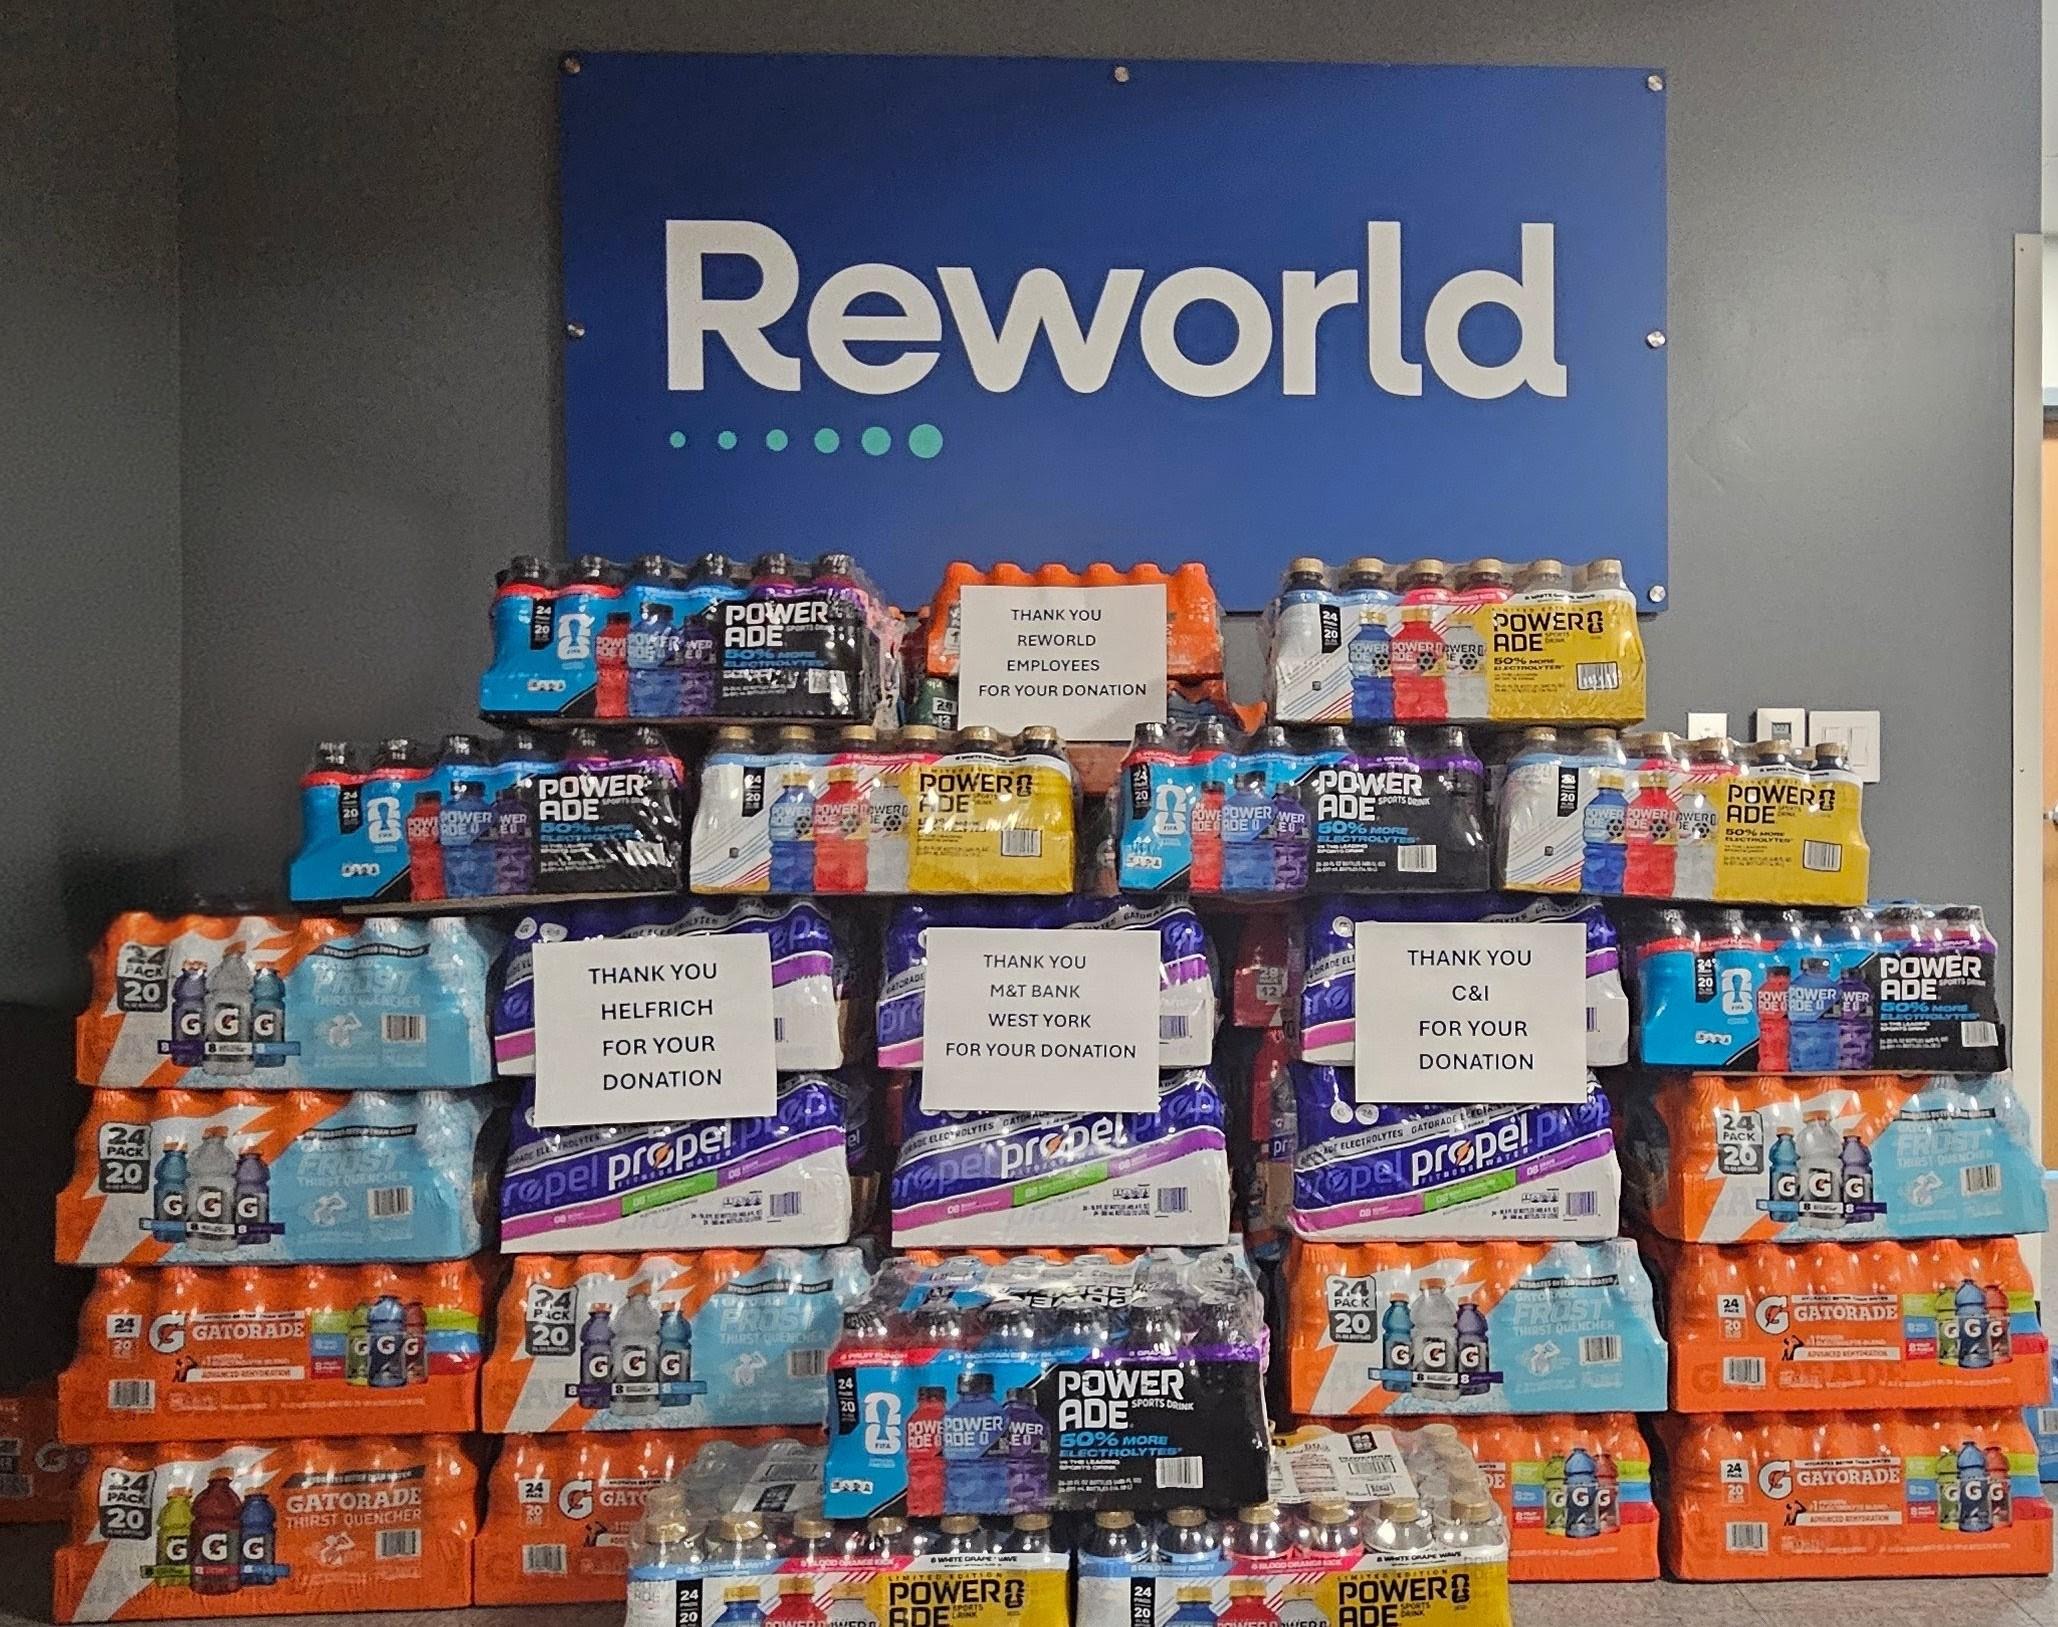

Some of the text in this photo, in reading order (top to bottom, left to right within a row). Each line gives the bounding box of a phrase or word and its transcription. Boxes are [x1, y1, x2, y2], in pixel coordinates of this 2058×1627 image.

[666, 220, 1568, 401] Reworld
[726, 602, 828, 626] POWER
[1011, 609, 1101, 621] THANK YOU
[1493, 613, 1584, 632] POWER
[725, 625, 783, 648] ADE
[1018, 634, 1096, 646] REWORLD
[1494, 634, 1543, 652] ADE
[1007, 660, 1100, 672] EMPLOYEES
[979, 684, 1147, 697] FOR YOUR DONATION
[540, 775, 644, 799] POWER
[920, 774, 1012, 792] POWER
[1319, 770, 1422, 795] POWER
[1378, 797, 1430, 806] SPORTS DRINK
[1728, 784, 1815, 805] POWER
[540, 799, 599, 820] ADE
[1224, 806, 1272, 819] POWER
[1318, 794, 1376, 821] ADE
[1628, 809, 1668, 819] POWER
[1727, 805, 1776, 824] ADE
[1318, 821, 1367, 834] 50%
[984, 955, 1086, 969] THANK YOU
[1408, 950, 1532, 966] THANK YOU
[1880, 956, 1981, 978] POWER
[124, 964, 164, 977] PACK
[588, 963, 717, 985] THANK YOU
[124, 981, 161, 1002] 20
[990, 984, 1080, 998] M&T BANK
[1881, 979, 1936, 1000] ADE
[1939, 978, 1965, 986] SPORTS
[1452, 985, 1488, 1001] C&I
[1789, 987, 1836, 1000] POWER
[601, 999, 713, 1020] HELFRICH
[215, 1008, 239, 1036] G
[989, 1014, 1091, 1028] WEST YORK
[1419, 1021, 1528, 1037] FOR YOUR
[603, 1036, 715, 1056] FOR YOUR
[946, 1043, 1136, 1058] FOR YOUR DONATION
[1420, 1054, 1533, 1070] DONATION
[603, 1069, 722, 1090] DONATION
[1411, 1115, 1457, 1135] GATORADE
[1723, 1114, 1755, 1131] 24
[108, 1127, 146, 1145] 24
[1001, 1112, 1126, 1179] propel
[1340, 1128, 1403, 1150] ELECTROLYTES
[1723, 1132, 1755, 1141] PACK
[107, 1146, 144, 1157] PACK
[608, 1119, 732, 1192] propel
[1411, 1113, 1529, 1187] propel
[1724, 1146, 1757, 1166] 20
[106, 1162, 142, 1185] 20
[1809, 1173, 1832, 1197] G
[1846, 1177, 1864, 1197] G
[198, 1192, 222, 1218] G
[1334, 1299, 1369, 1307] PACK
[1515, 1300, 1603, 1325] FROST
[1723, 1299, 1739, 1308] 24
[1794, 1305, 1897, 1321] GATORADE
[114, 1318, 134, 1329] 24
[1335, 1313, 1370, 1333] 20
[1755, 1296, 1788, 1335] G
[150, 1314, 186, 1353] G
[192, 1323, 305, 1341] GATORADE
[532, 1325, 569, 1346] 20
[1964, 1318, 1982, 1339] G
[377, 1336, 396, 1354] G
[1391, 1345, 1409, 1365] G
[1424, 1342, 1446, 1367] G
[623, 1350, 646, 1377] G
[661, 1354, 680, 1375] G
[1460, 1346, 1479, 1367] G
[589, 1356, 608, 1378] G
[1058, 1369, 1184, 1400] POWER
[1131, 1399, 1194, 1410] SPORTS DRINK
[945, 1416, 1002, 1431] POWER
[1059, 1398, 1128, 1432] ADE
[1060, 1432, 1168, 1448] 50% MORE
[1060, 1448, 1178, 1458] ELECTROLYTES
[1727, 1464, 1742, 1473] 24
[1797, 1469, 1900, 1486] GATORADE
[1759, 1461, 1792, 1500] G
[1965, 1481, 1982, 1500] G
[108, 1492, 147, 1504] PACK
[286, 1488, 422, 1513] GATORADE
[558, 1479, 592, 1519] G
[1571, 1487, 1589, 1506] G
[107, 1508, 145, 1529] 20
[286, 1509, 422, 1529] THIRST QUENCHER
[1810, 1515, 1844, 1523] ADVANCED
[202, 1533, 227, 1561] G
[242, 1538, 264, 1560] G
[1384, 1554, 1409, 1562] WHITE
[1397, 1569, 1448, 1578] EDITION
[680, 1590, 698, 1600] 24
[889, 1579, 1000, 1605] POWER
[1134, 1587, 1152, 1597] 24
[1339, 1576, 1448, 1604] POWER
[680, 1612, 698, 1623] 20
[1134, 1608, 1151, 1618] 20
[1339, 1604, 1397, 1627] ADE
